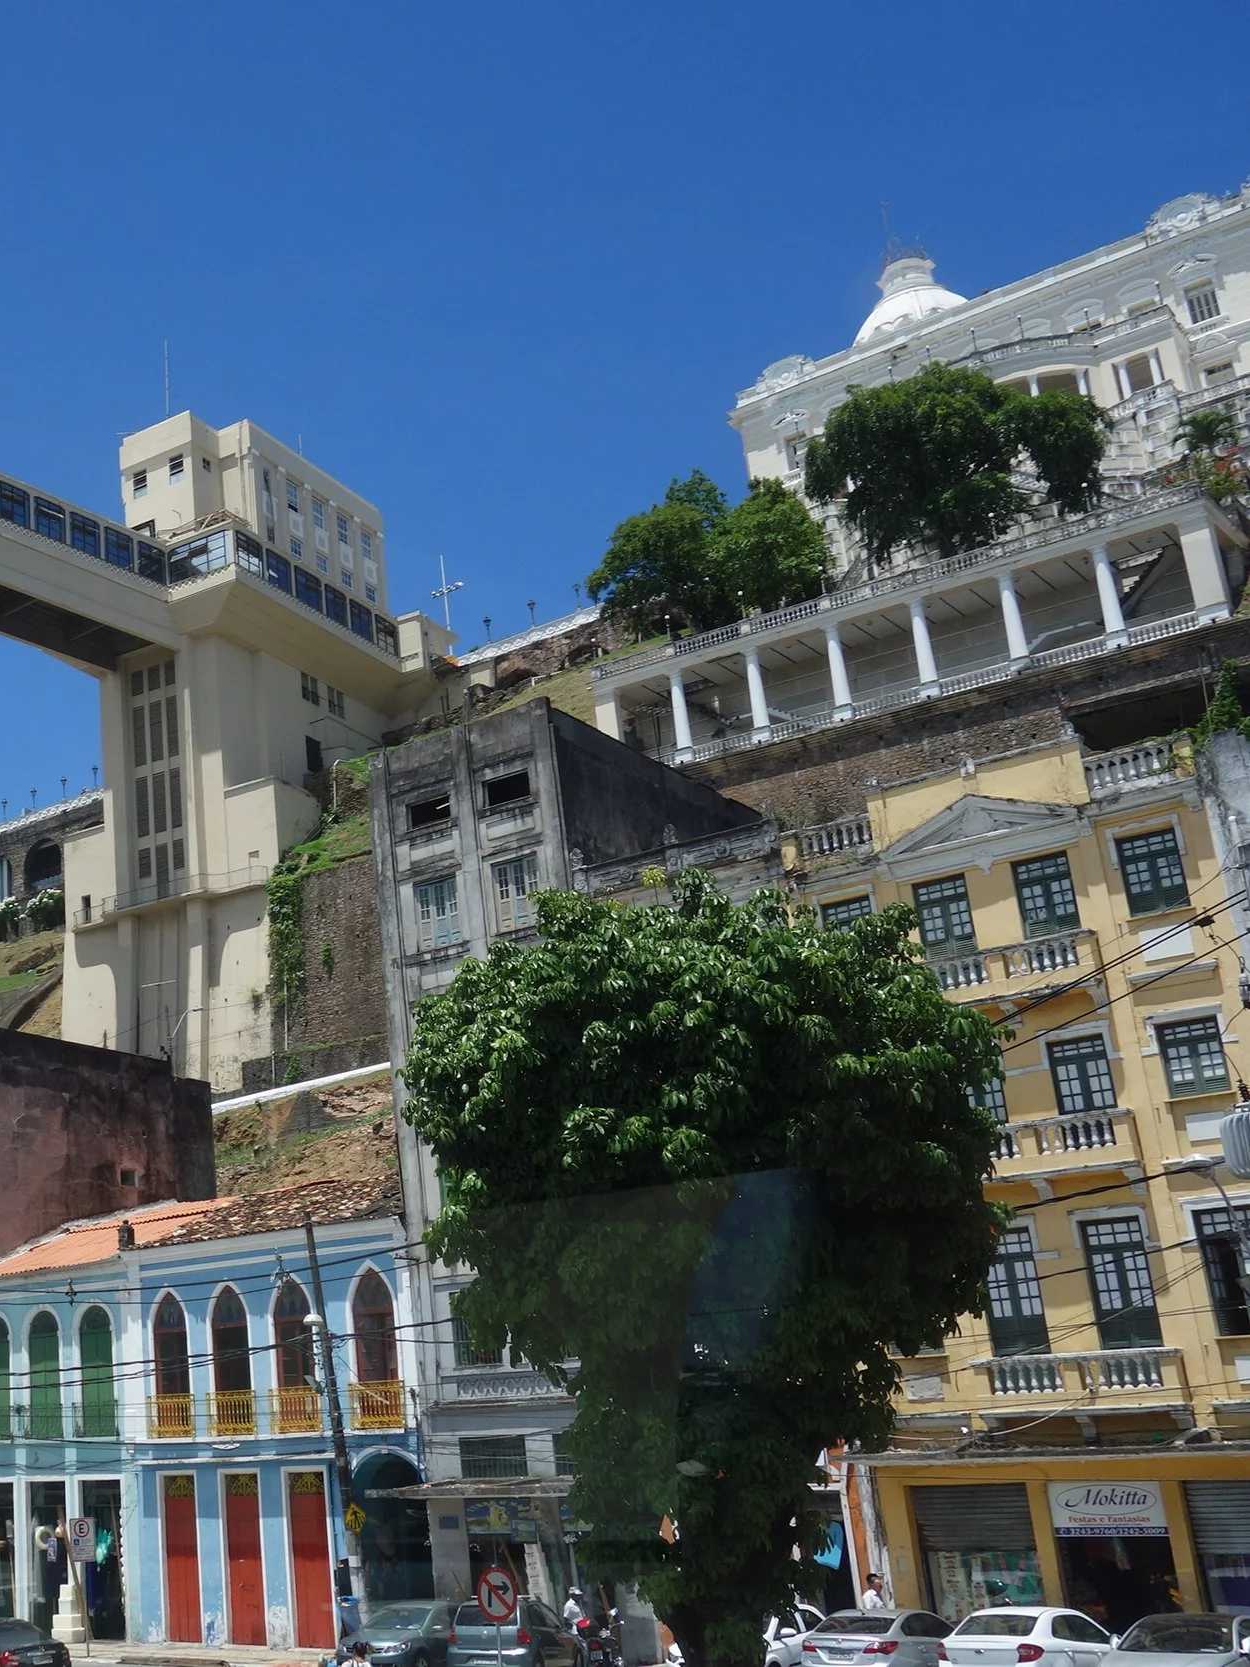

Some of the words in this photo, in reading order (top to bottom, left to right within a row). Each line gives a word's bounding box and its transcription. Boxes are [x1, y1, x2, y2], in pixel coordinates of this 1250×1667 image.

[1065, 1488, 1148, 1508] Mokitta
[1107, 1515, 1151, 1523] Fantasias
[79, 1523, 85, 1534] E
